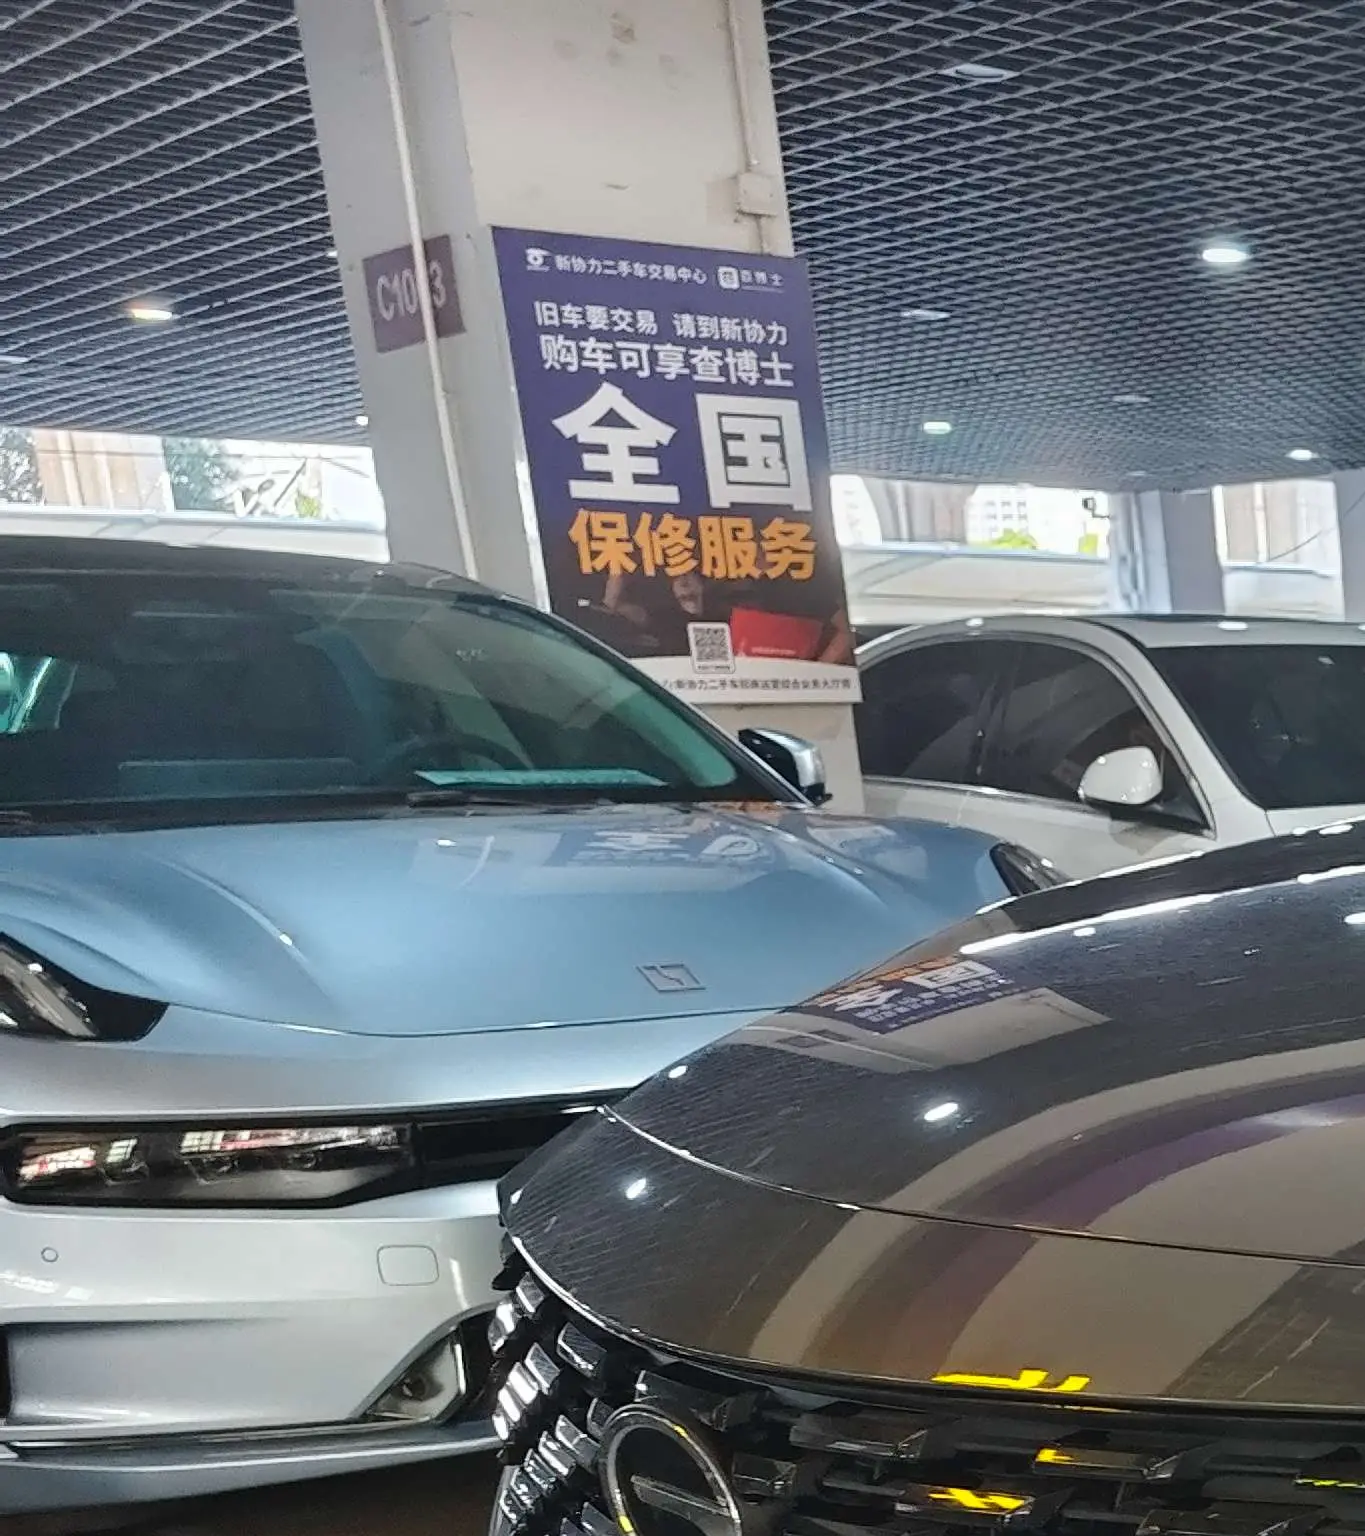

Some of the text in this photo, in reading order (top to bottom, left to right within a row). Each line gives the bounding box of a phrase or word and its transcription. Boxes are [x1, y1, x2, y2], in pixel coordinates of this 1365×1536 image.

[377, 258, 446, 321] C103
[555, 254, 707, 285] 新协力二手车交易中心
[534, 301, 789, 345] 旧车要交易 请到新协力
[540, 335, 794, 387] 购车可享查博士
[552, 382, 812, 511] 全国
[568, 507, 818, 582] 保修服务
